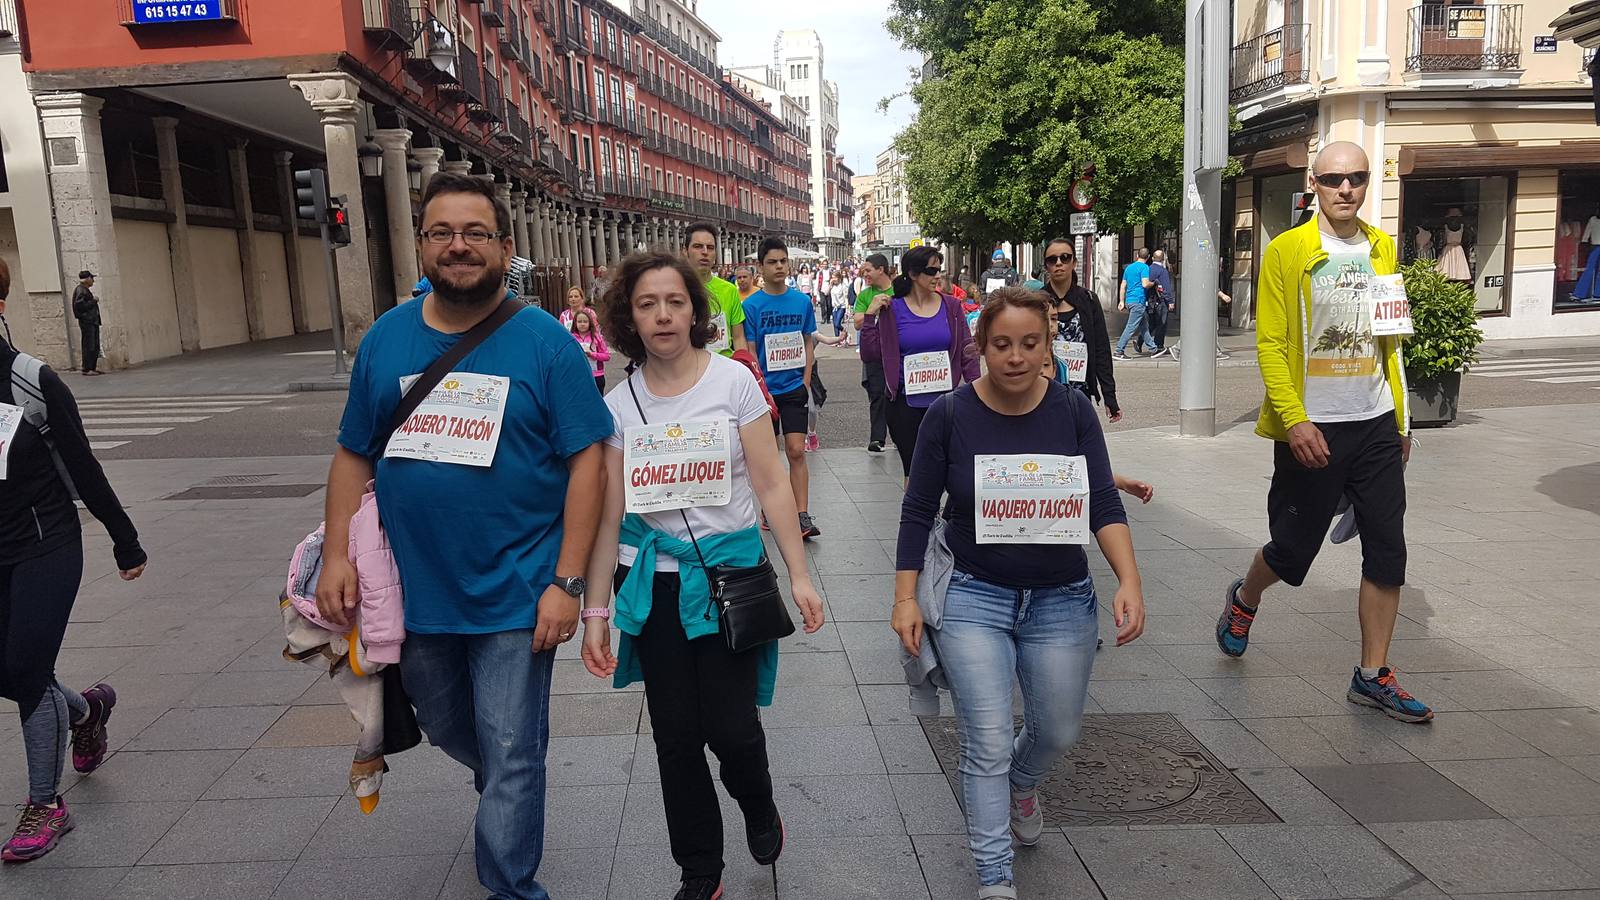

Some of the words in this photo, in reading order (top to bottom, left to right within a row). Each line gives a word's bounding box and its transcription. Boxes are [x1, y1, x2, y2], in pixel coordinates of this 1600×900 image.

[145, 6, 164, 18] 615
[166, 5, 178, 17] 15
[180, 5, 192, 16] 47
[194, 4, 207, 16] 43
[1449, 9, 1459, 20] SE
[1460, 9, 1485, 20] ALQUILA
[1313, 274, 1336, 288] LOS
[761, 314, 803, 329] FASTER
[908, 368, 948, 385] ATIBRISAF
[447, 415, 495, 441] TASCÓN
[631, 461, 677, 487] GÓMEZ
[680, 461, 725, 484] LUQUE
[982, 499, 1037, 521] VAQUERO
[1039, 494, 1083, 519] TASCÓN
